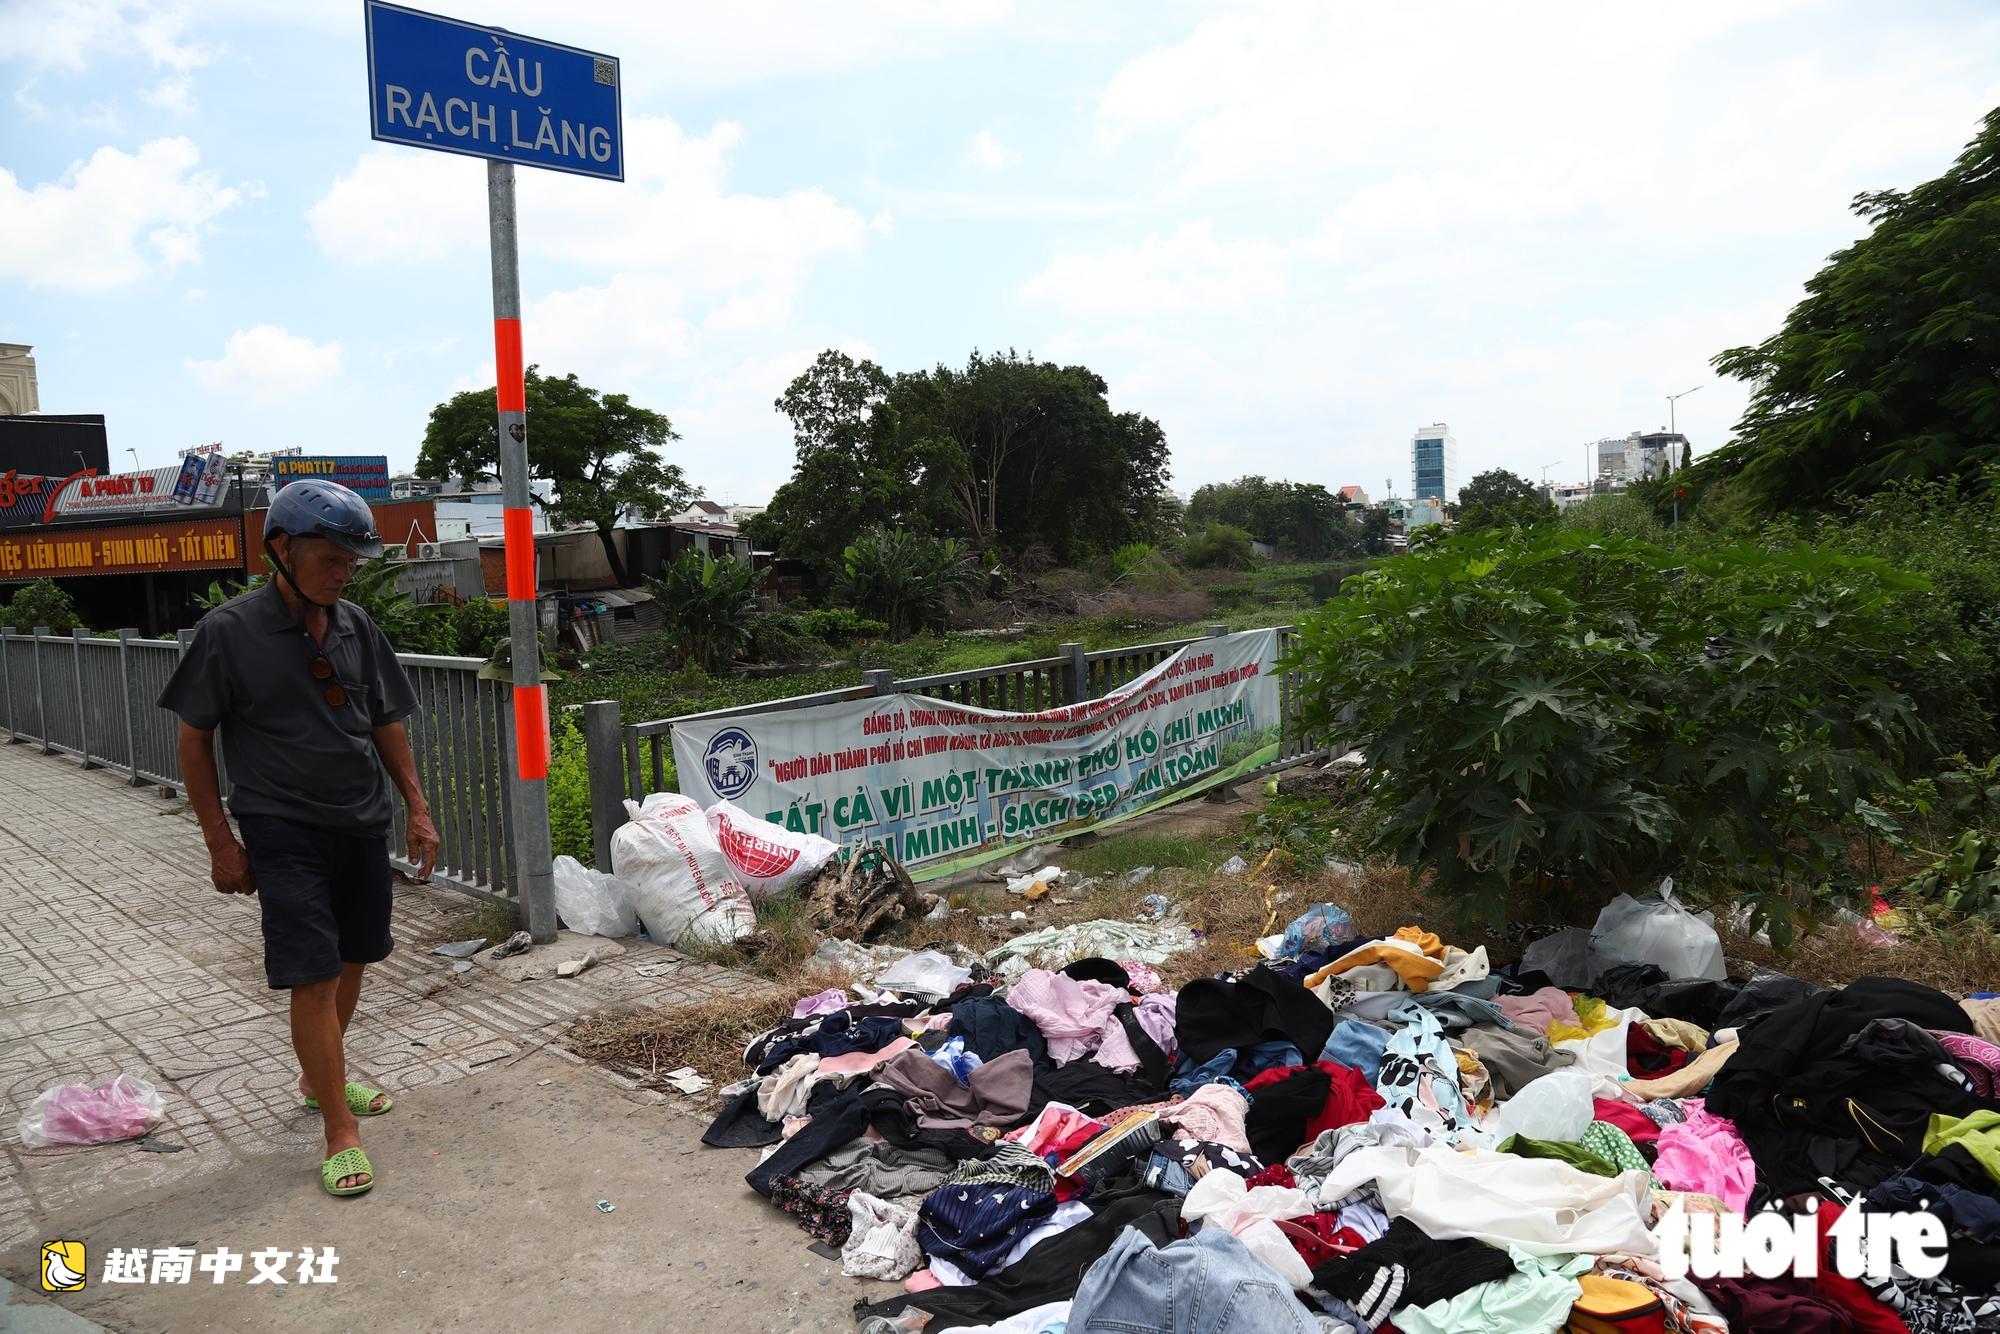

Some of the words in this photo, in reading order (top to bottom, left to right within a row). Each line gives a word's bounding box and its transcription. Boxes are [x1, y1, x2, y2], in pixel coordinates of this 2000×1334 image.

[465, 36, 543, 97] CẦU
[385, 84, 497, 140] RẠCH
[511, 106, 611, 163] LĂNG
[95, 476, 134, 496] PHÁT
[138, 476, 155, 493] 17
[26, 539, 56, 569] LIÊN
[56, 541, 93, 568] HOAN
[102, 540, 135, 566] SINH
[135, 533, 169, 568] NHẬT
[178, 529, 201, 562] TẤT
[202, 530, 236, 560] NIÊN
[1197, 652, 1214, 673] ĐỘNG
[764, 794, 823, 834] TẤT
[833, 785, 874, 828] CẢ
[880, 777, 912, 817] VÌ
[921, 769, 977, 810] MỘT
[985, 758, 1070, 794] THÀNH
[1077, 734, 1119, 777] PHỐ
[1125, 722, 1158, 761] HỒ
[1163, 712, 1192, 746] CHÍ
[1197, 698, 1243, 735] MINH
[809, 752, 832, 777] DÂN
[833, 747, 868, 772] THÀNH
[869, 738, 891, 766] PHỐ
[892, 736, 905, 762] HỒ
[907, 735, 923, 759] CHÍ
[923, 735, 949, 756] MINH
[904, 816, 978, 862] MINH
[1004, 798, 1070, 836] SẠCH
[1077, 783, 1118, 817] ĐẸP
[1133, 764, 1163, 796] AN
[1165, 745, 1218, 783] TOÀN
